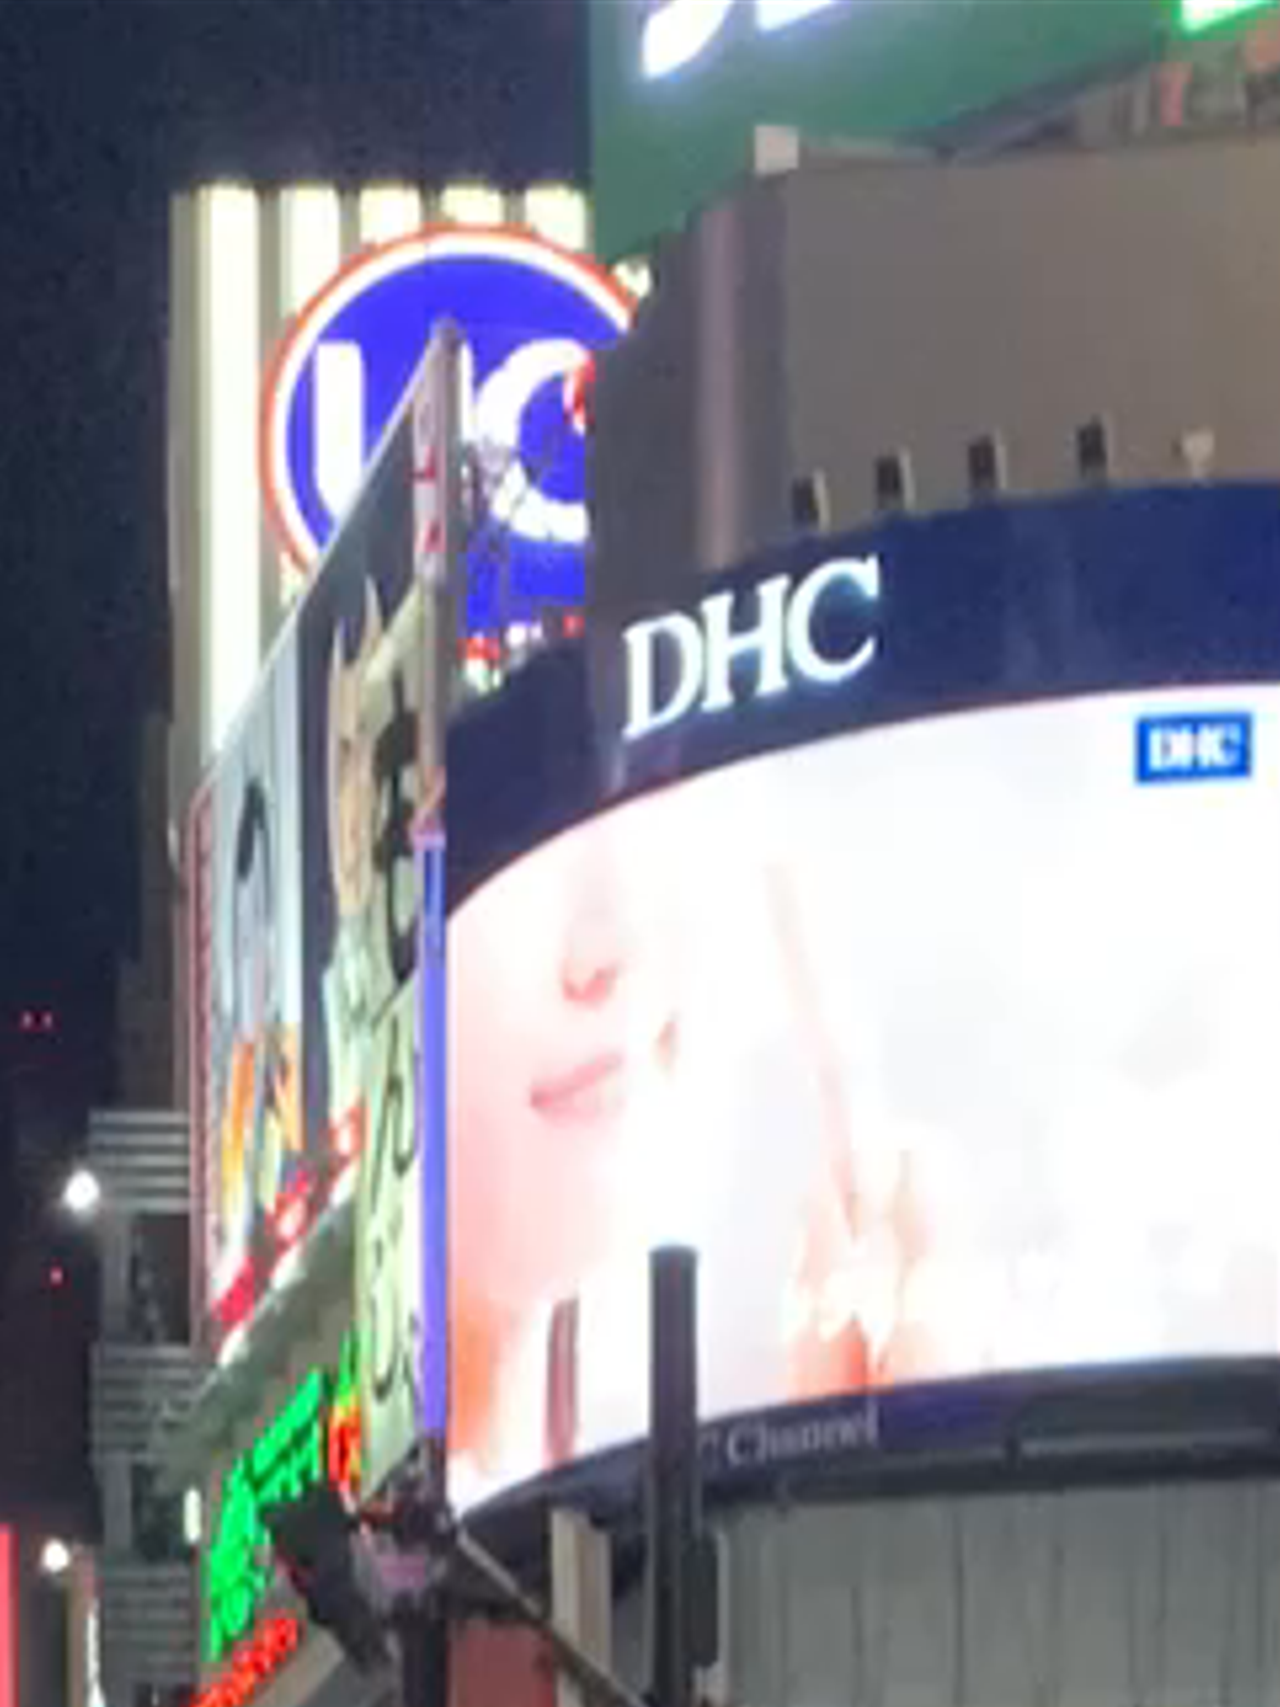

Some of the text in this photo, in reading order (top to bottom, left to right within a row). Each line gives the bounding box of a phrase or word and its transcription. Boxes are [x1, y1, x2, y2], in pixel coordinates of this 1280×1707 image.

[622, 552, 880, 742] DHC
[1148, 722, 1242, 771] DHC
[726, 1397, 878, 1467] Channel
